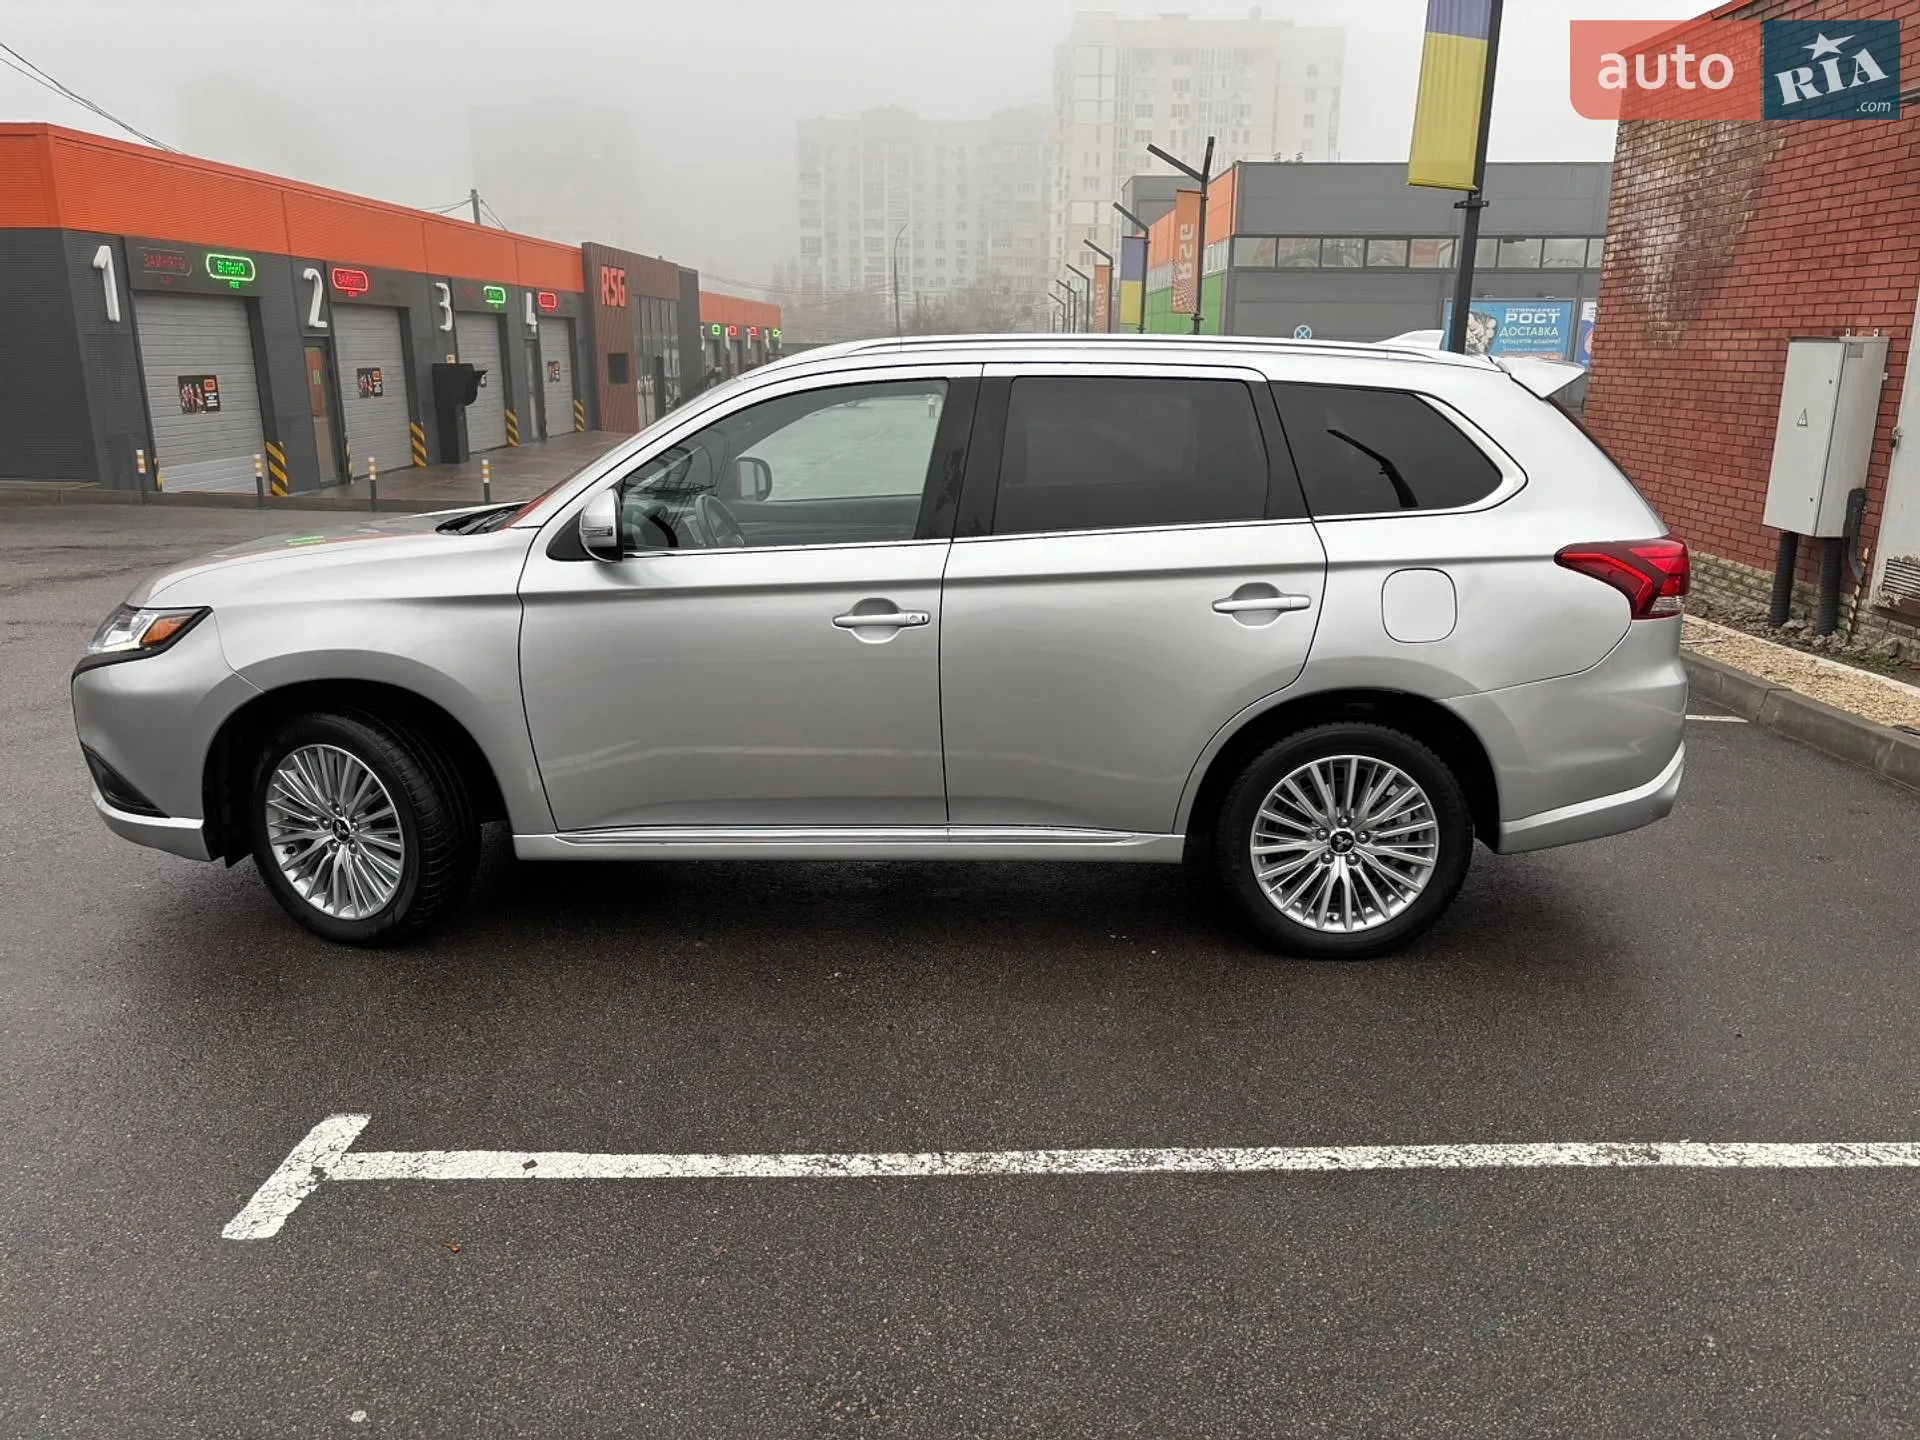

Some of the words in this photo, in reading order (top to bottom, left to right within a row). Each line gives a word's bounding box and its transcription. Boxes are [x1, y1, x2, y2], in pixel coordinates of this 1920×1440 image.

[92, 245, 121, 322] 1
[302, 268, 328, 328] 2
[601, 265, 627, 308] RSG
[435, 282, 454, 332] 3
[525, 292, 538, 333] 4
[1504, 313, 1561, 324] РОСТ
[1499, 327, 1559, 338] ДОСТАВКА
